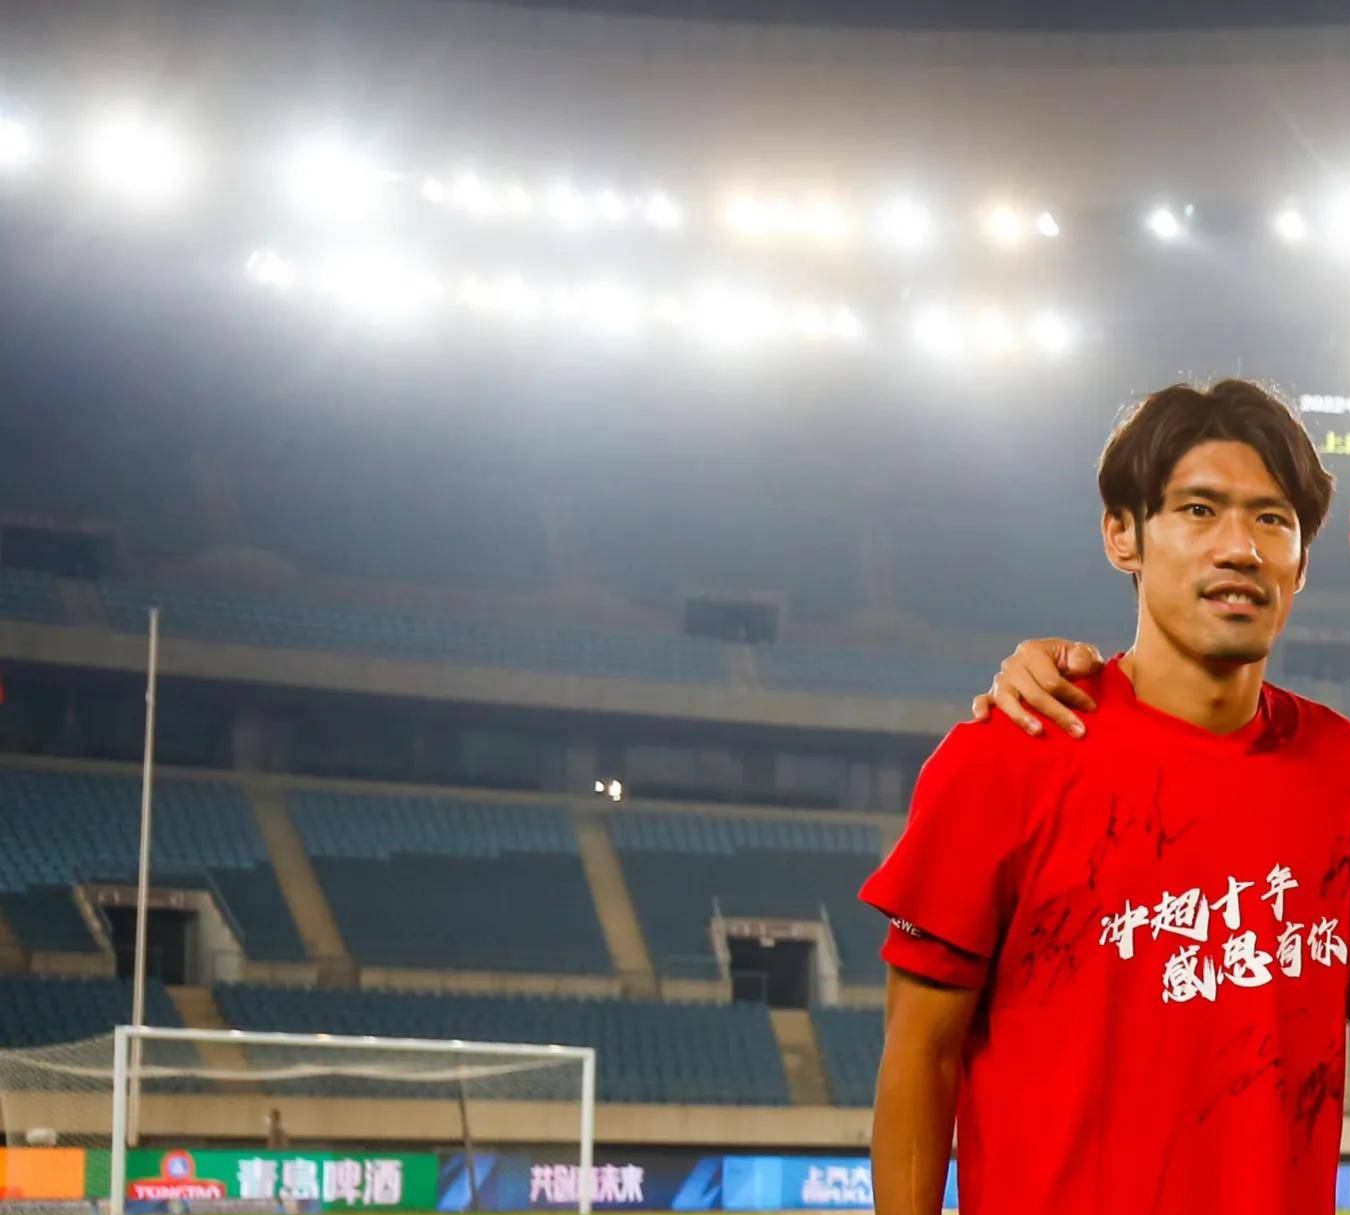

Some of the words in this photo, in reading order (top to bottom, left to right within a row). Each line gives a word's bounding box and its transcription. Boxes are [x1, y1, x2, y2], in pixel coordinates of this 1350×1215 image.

[1099, 864, 1299, 960] 冲超十年
[1162, 917, 1348, 1004] 感恩有你
